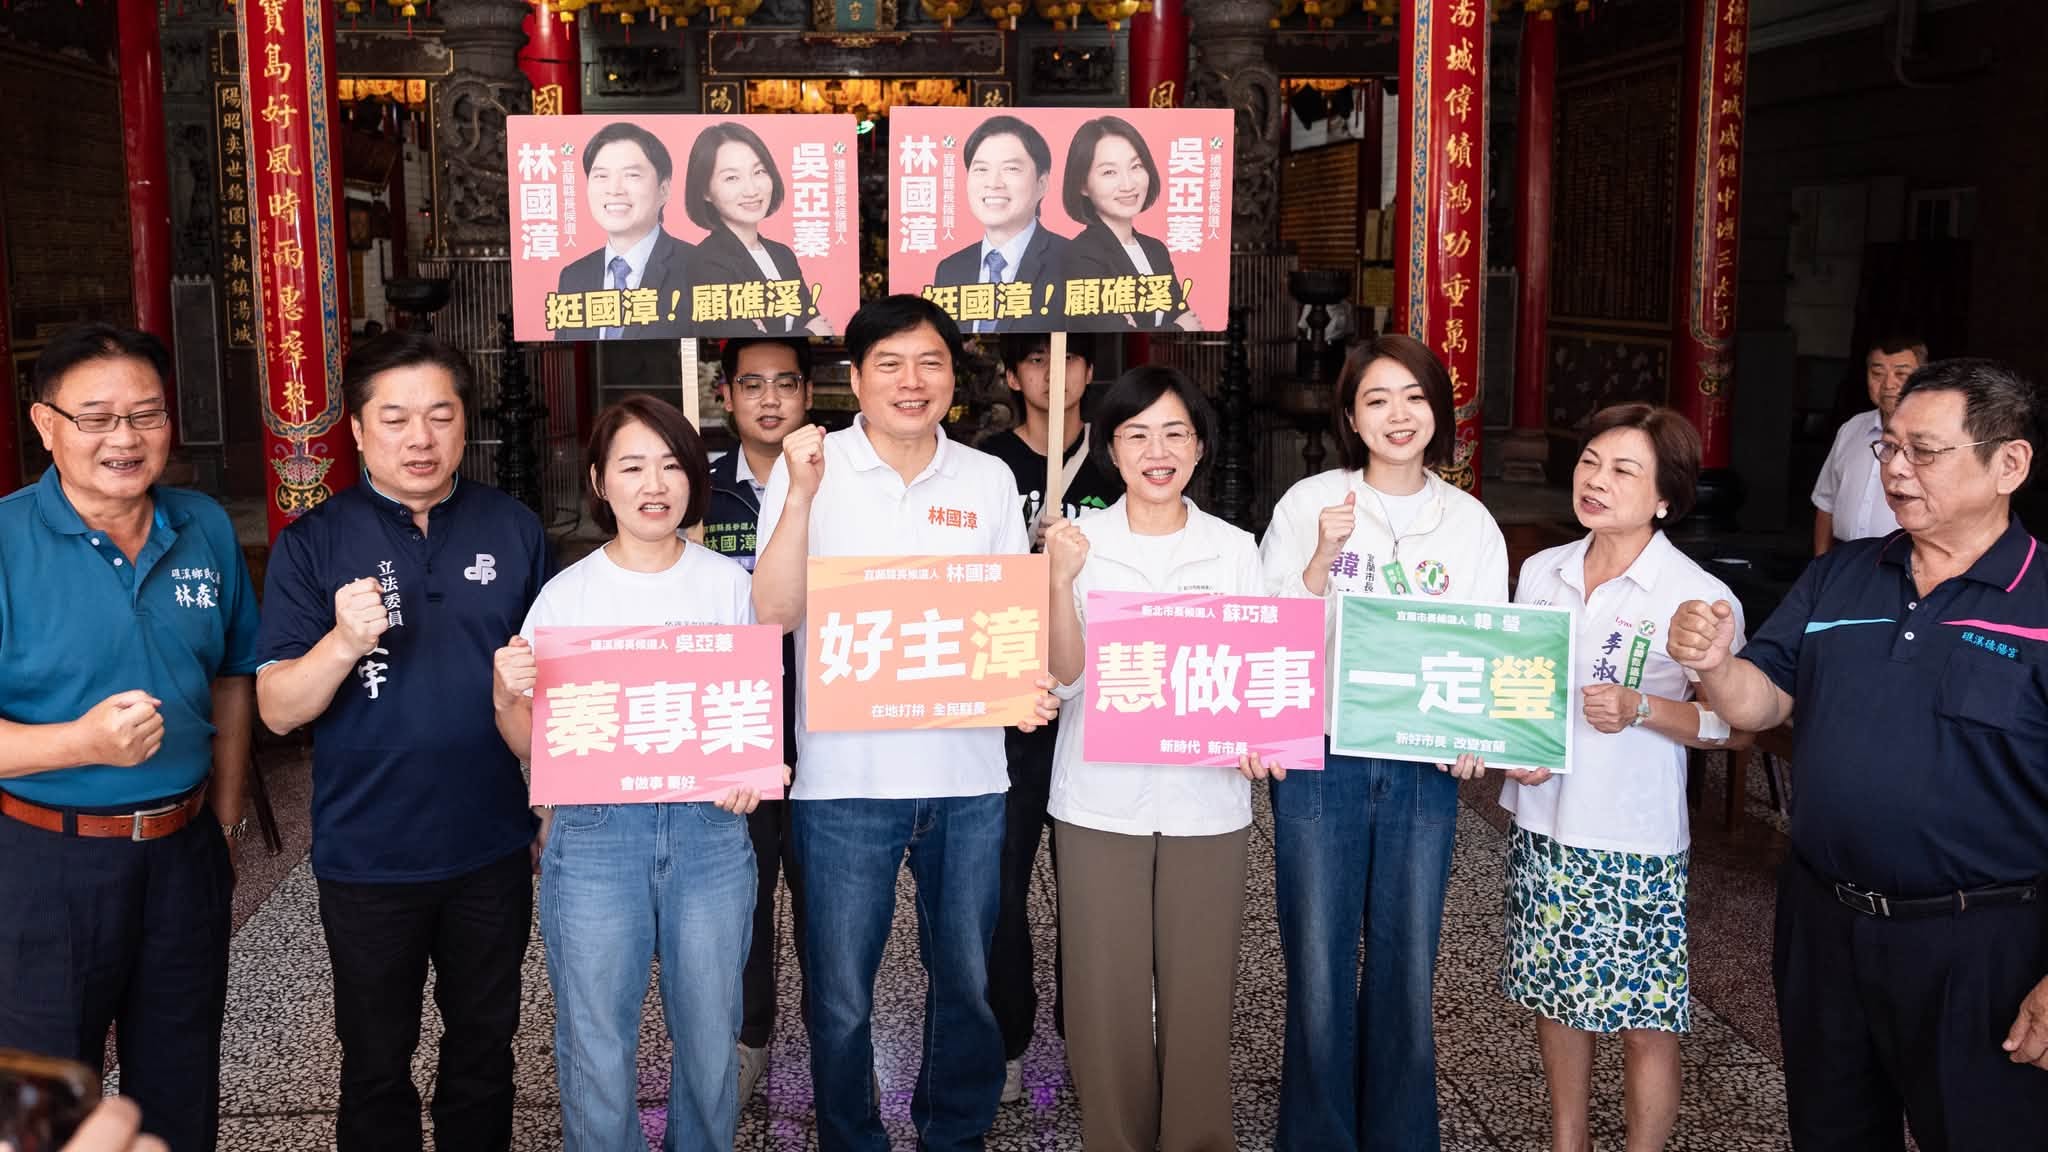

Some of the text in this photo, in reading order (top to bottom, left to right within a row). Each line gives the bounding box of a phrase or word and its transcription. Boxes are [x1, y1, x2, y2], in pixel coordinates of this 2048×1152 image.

[518, 143, 560, 261] 林國漳
[561, 160, 577, 247] 宜蘭縣長候選人
[792, 142, 830, 257] 吳亞蓁
[834, 159, 848, 245] 礁溪鄉長候選人
[899, 135, 938, 253] 林國漳
[943, 154, 956, 240] 宜蘭縣長候選人
[1167, 137, 1205, 253] 吳亞蓁
[1208, 154, 1221, 239] 礁溪鄉長候選人
[928, 506, 978, 530] 林國漳
[377, 560, 404, 628] 立法委員
[863, 563, 1002, 583] 宜蘭縣長候選人 林國漳
[591, 633, 734, 654] 礁溪鄉長候選人 吳亞蓁
[819, 605, 1041, 685] 好主漳
[1223, 603, 1279, 624] 蘇巧慧
[1396, 611, 1467, 626] 宜蘭市長候選人
[932, 701, 986, 717] 全民縣長
[1095, 641, 1316, 718] 慧做事
[1349, 651, 1556, 720] 一定瑩
[545, 679, 774, 758] 蓁專業
[1160, 739, 1249, 756] 新時代 新市長
[1396, 732, 1505, 753] 新好市長 改變宜蘭
[621, 775, 664, 791] 會做事
